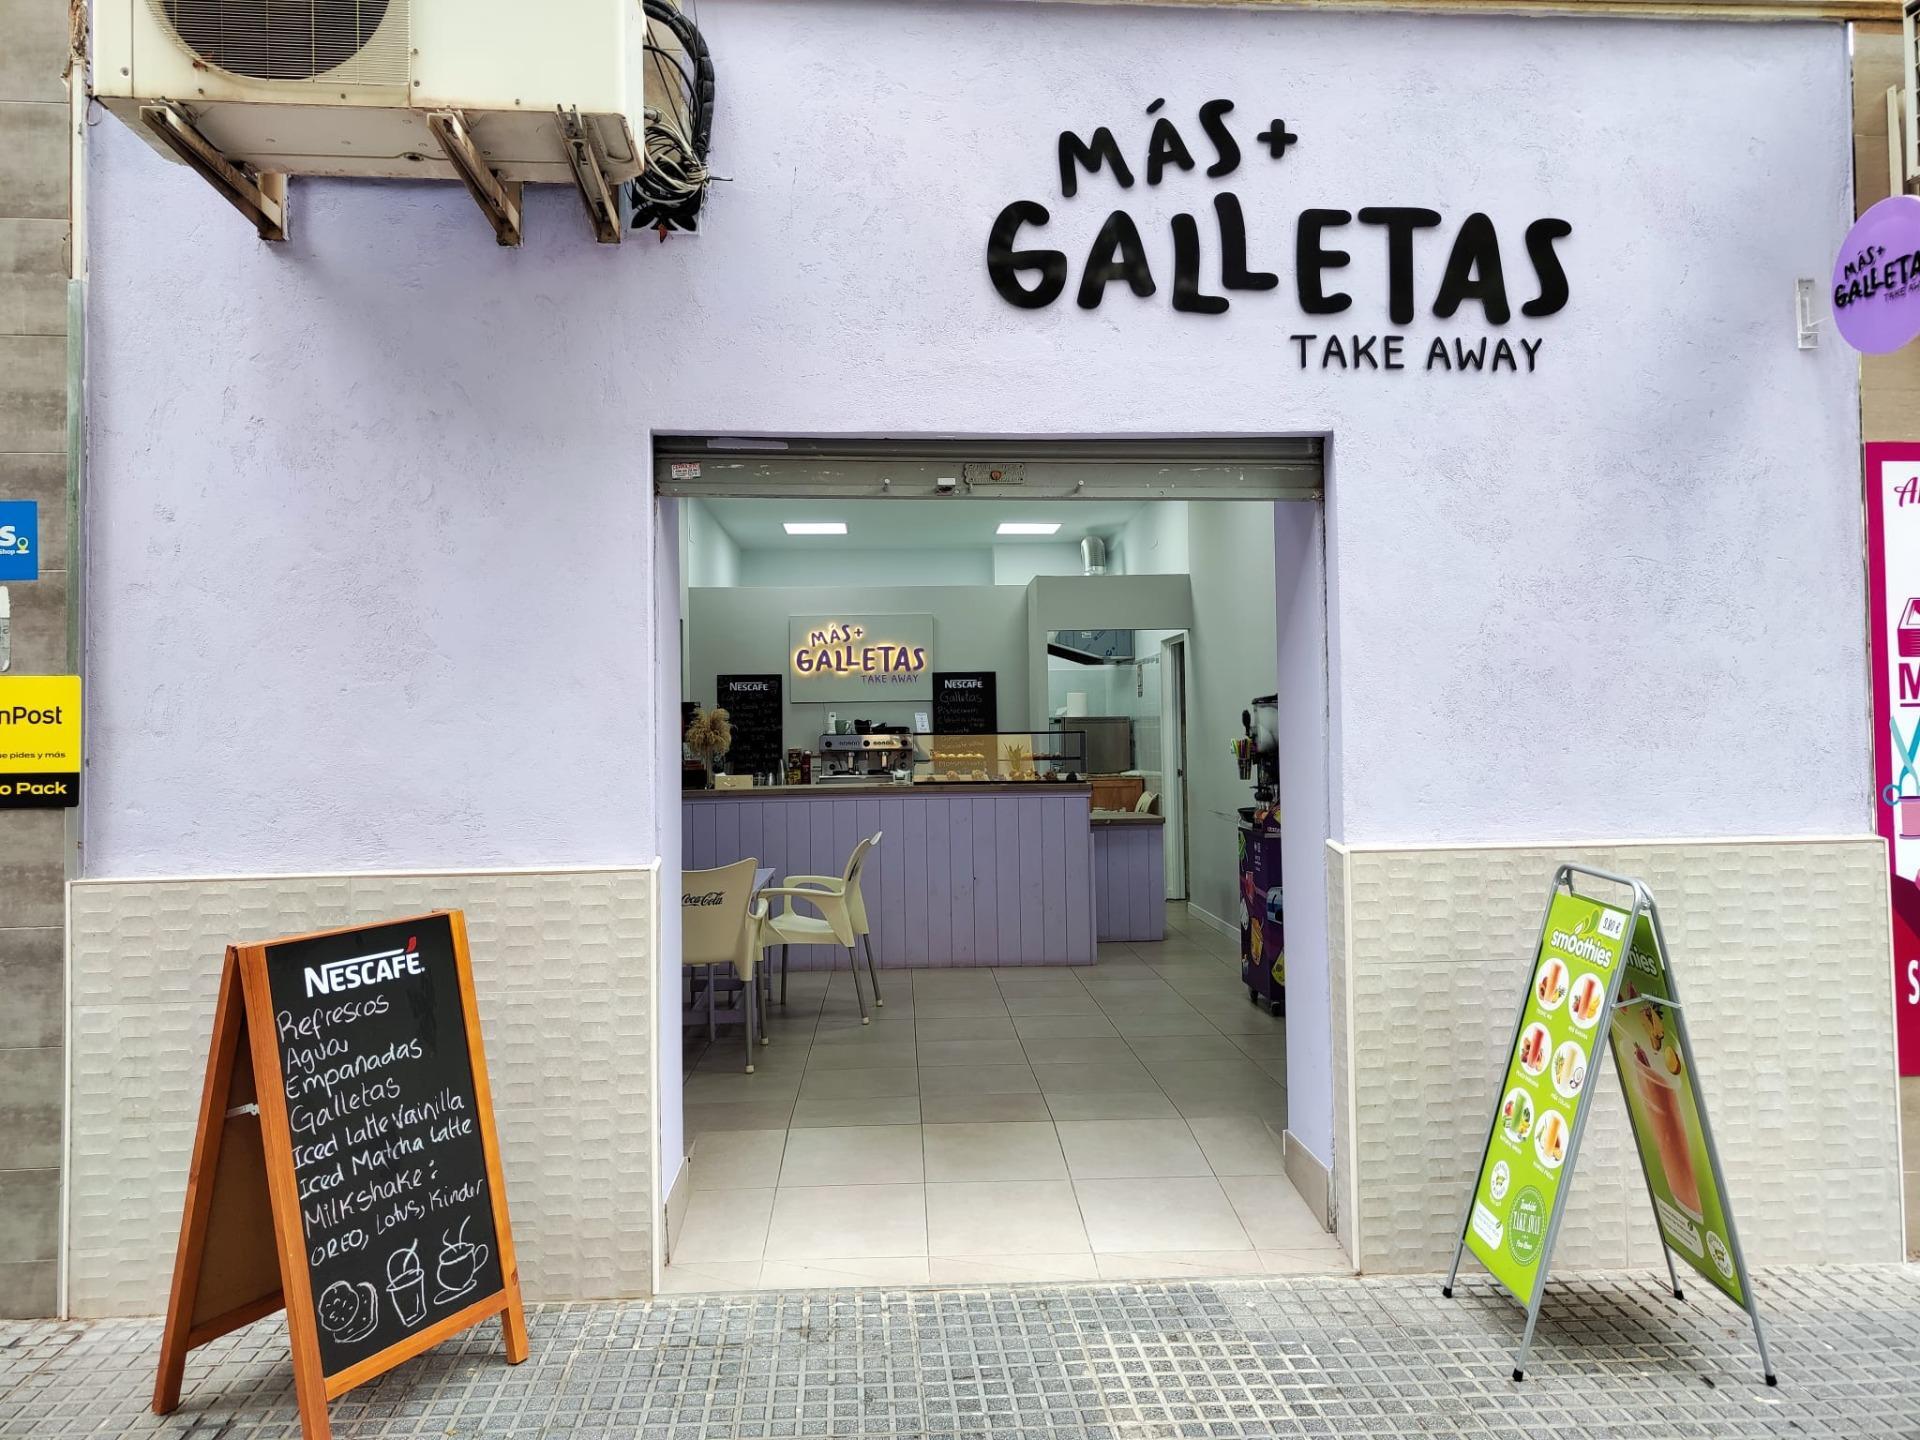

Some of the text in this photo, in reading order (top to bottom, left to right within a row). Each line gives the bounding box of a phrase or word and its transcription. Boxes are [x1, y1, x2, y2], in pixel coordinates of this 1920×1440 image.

[987, 192, 1572, 325] GALLETAS
[1290, 334, 1543, 373] TAKE AWAY
[796, 646, 925, 672] GALLETAS
[861, 674, 919, 684] TAKE AWAY
[9, 751, 36, 760] pides
[37, 752, 43, 760] y
[45, 750, 66, 759] más
[16, 781, 68, 795] Pack
[277, 995, 389, 1043] Refrescos
[286, 1037, 349, 1075] Agua
[286, 1037, 423, 1099] Empanadas
[291, 1077, 400, 1135] Galletas
[292, 1133, 338, 1170] Iced
[300, 1162, 345, 1200] Iced
[352, 1136, 424, 1176] Matcha
[311, 1229, 369, 1267] OREO,
[429, 1178, 483, 1212] Kinder
